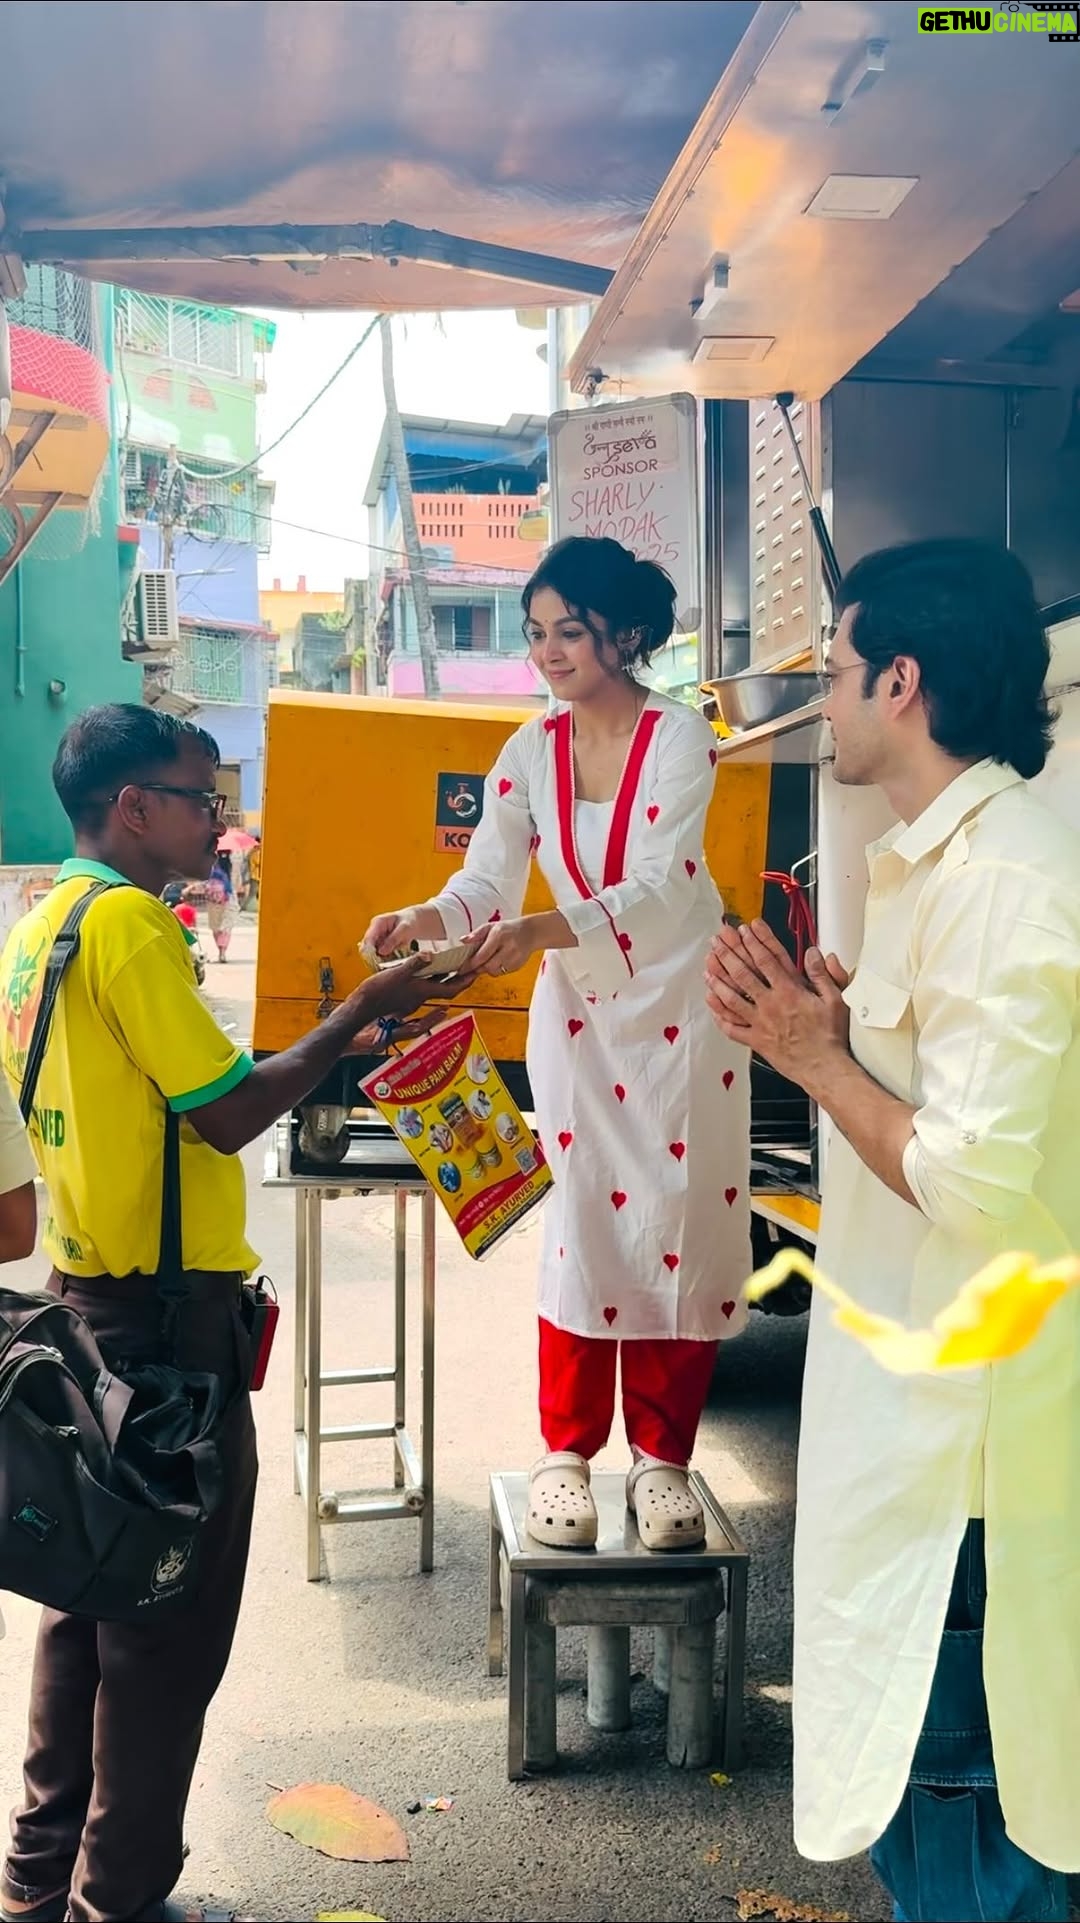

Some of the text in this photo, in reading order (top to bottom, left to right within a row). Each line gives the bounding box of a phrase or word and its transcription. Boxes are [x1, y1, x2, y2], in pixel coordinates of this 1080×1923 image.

[583, 458, 658, 480] SPONSOR
[568, 480, 655, 522] SHARLY
[584, 510, 670, 542] MODAK
[394, 1077, 432, 1099] UNIQUE
[430, 1068, 446, 1087] PAIN
[444, 1043, 463, 1072] BALM
[501, 1180, 535, 1215] AYURVED
